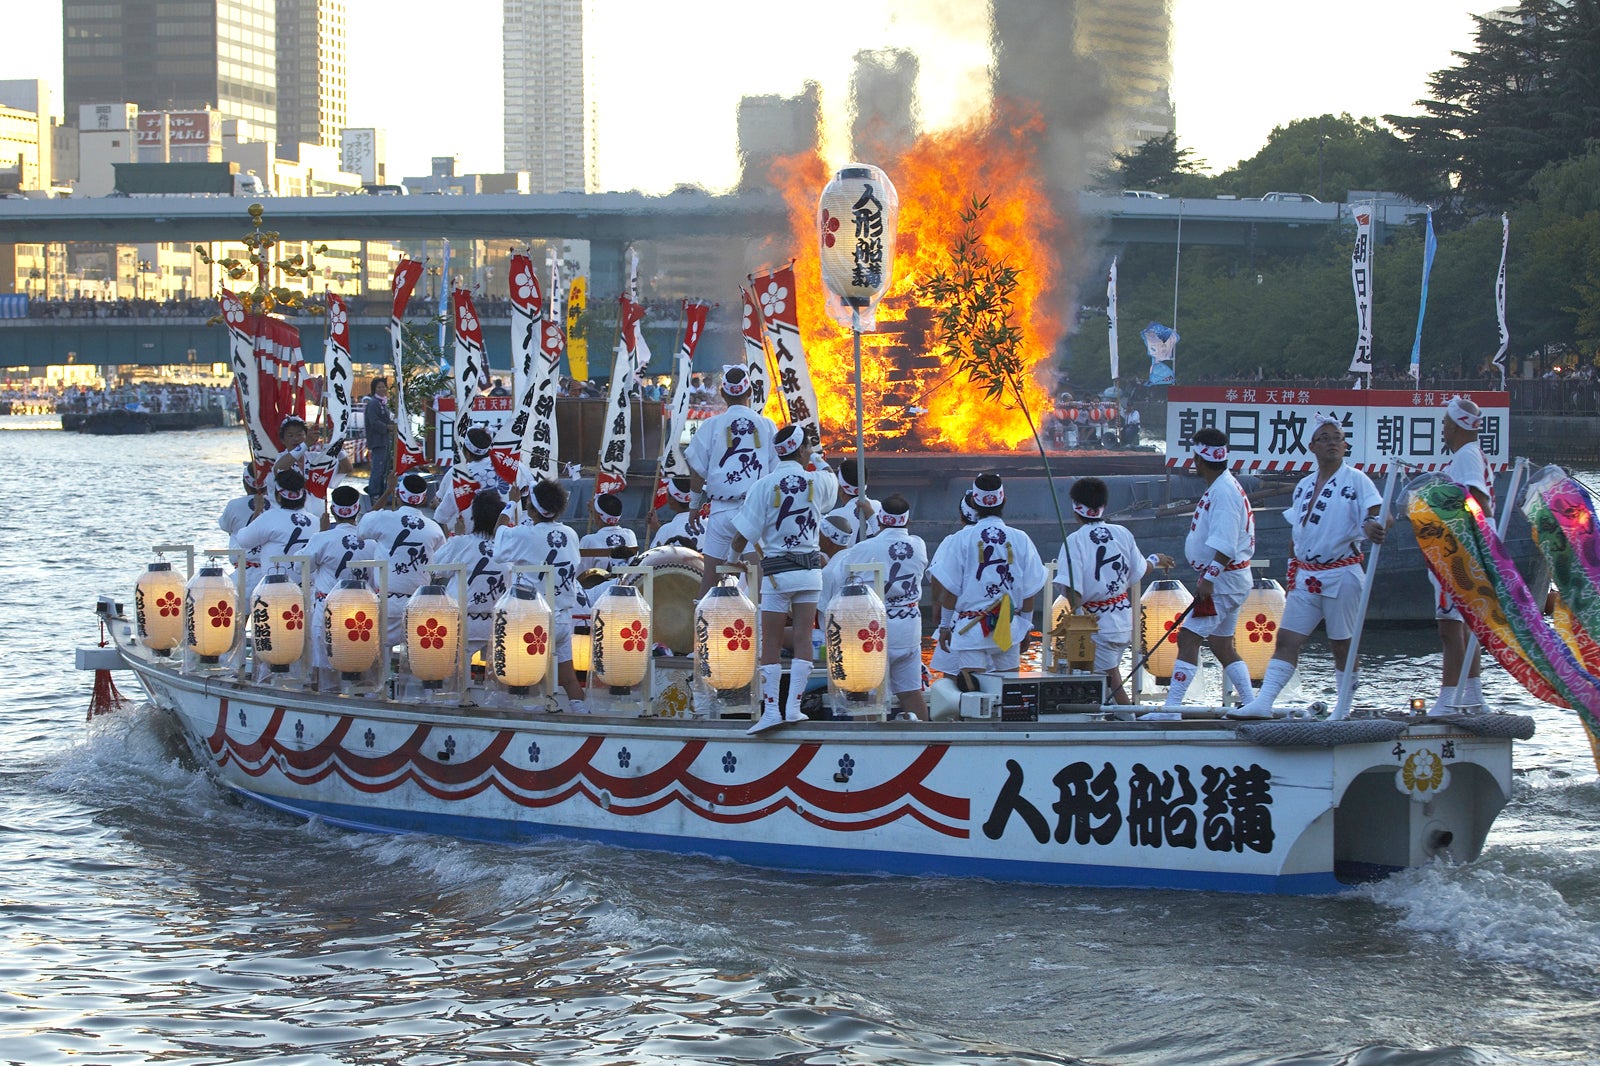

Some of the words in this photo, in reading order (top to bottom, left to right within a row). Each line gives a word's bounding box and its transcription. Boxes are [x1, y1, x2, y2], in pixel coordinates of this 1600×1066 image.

[851, 184, 883, 288] 人形船講
[472, 400, 486, 410] 祝
[1226, 389, 1256, 402] 奉祝
[1265, 390, 1310, 403] 天神祭
[1377, 415, 1500, 456] 朝日聞
[254, 595, 273, 652] 人形船講
[982, 759, 1273, 854] 人形船講
